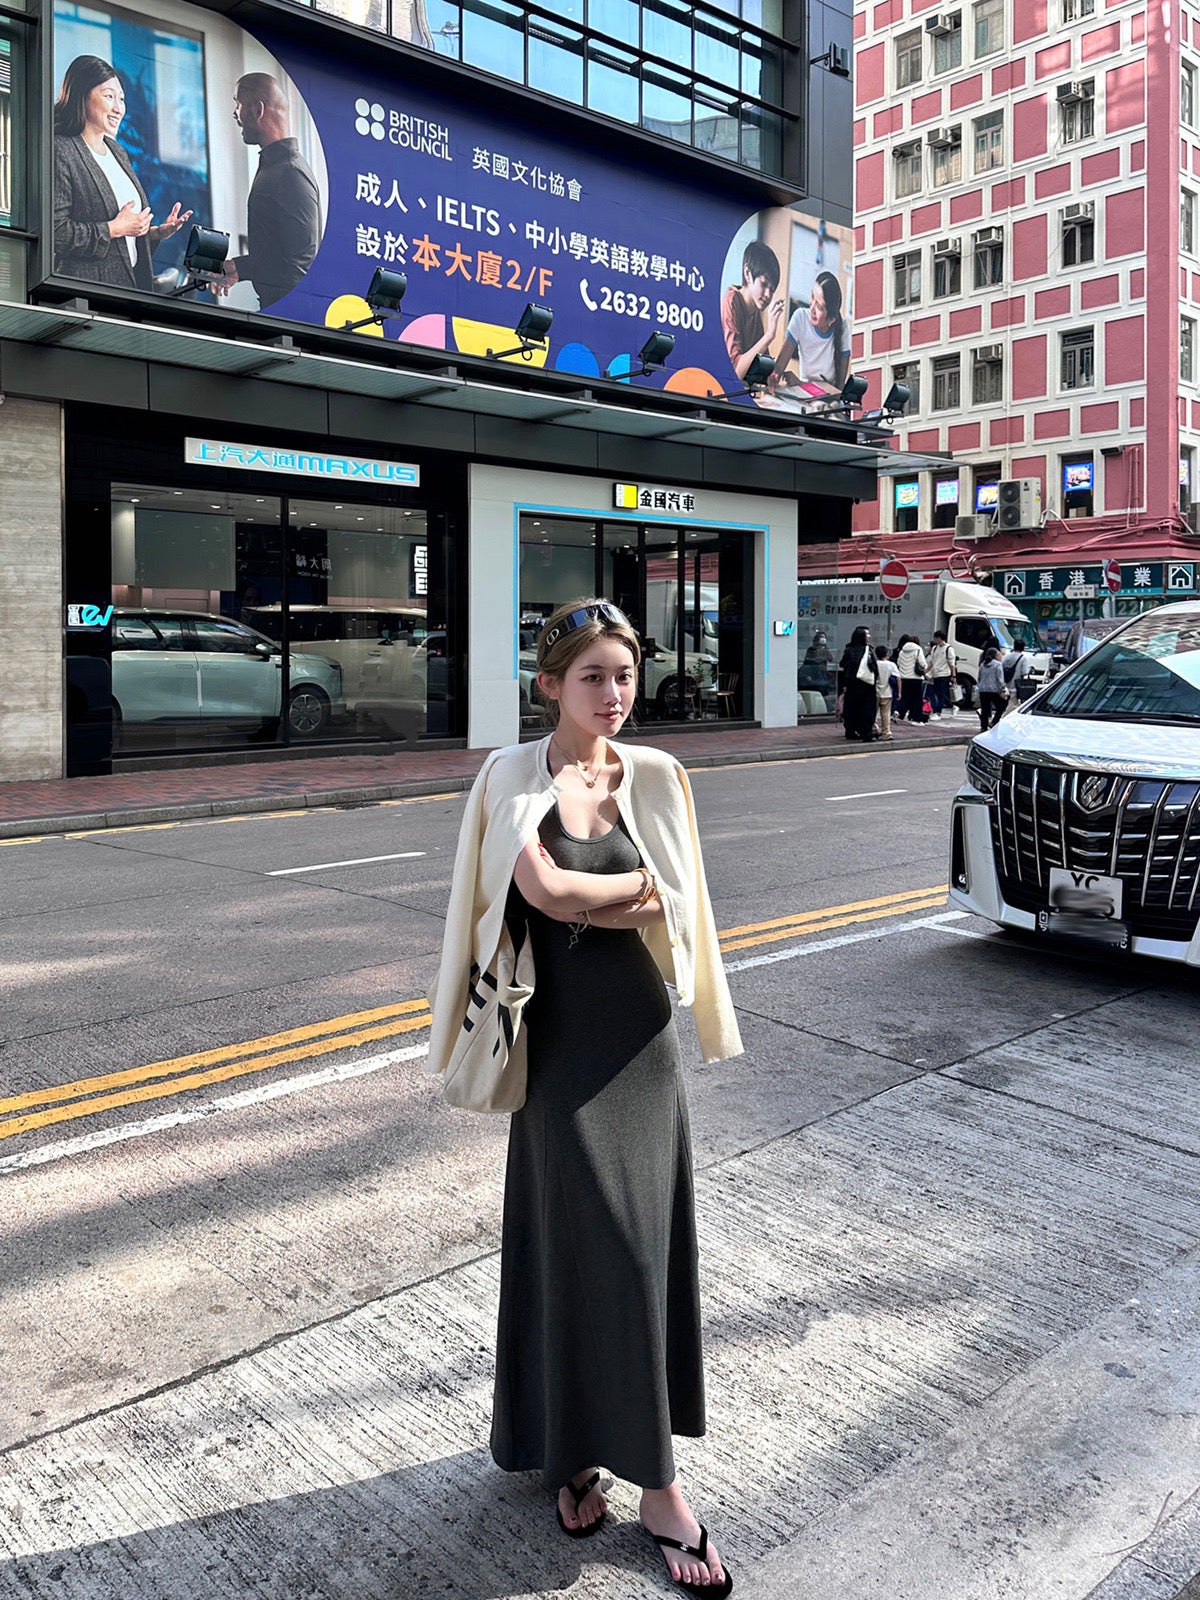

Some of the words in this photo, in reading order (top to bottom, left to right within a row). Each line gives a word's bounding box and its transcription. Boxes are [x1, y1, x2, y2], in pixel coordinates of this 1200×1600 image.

[388, 127, 453, 161] COUNCIL
[389, 109, 449, 143] BRITISH
[471, 147, 583, 201] 英國文化協會
[355, 224, 553, 297] 設於本大廈2/F
[600, 286, 651, 320] 2632
[656, 300, 704, 332] 9800
[639, 489, 695, 512] 金國汽車
